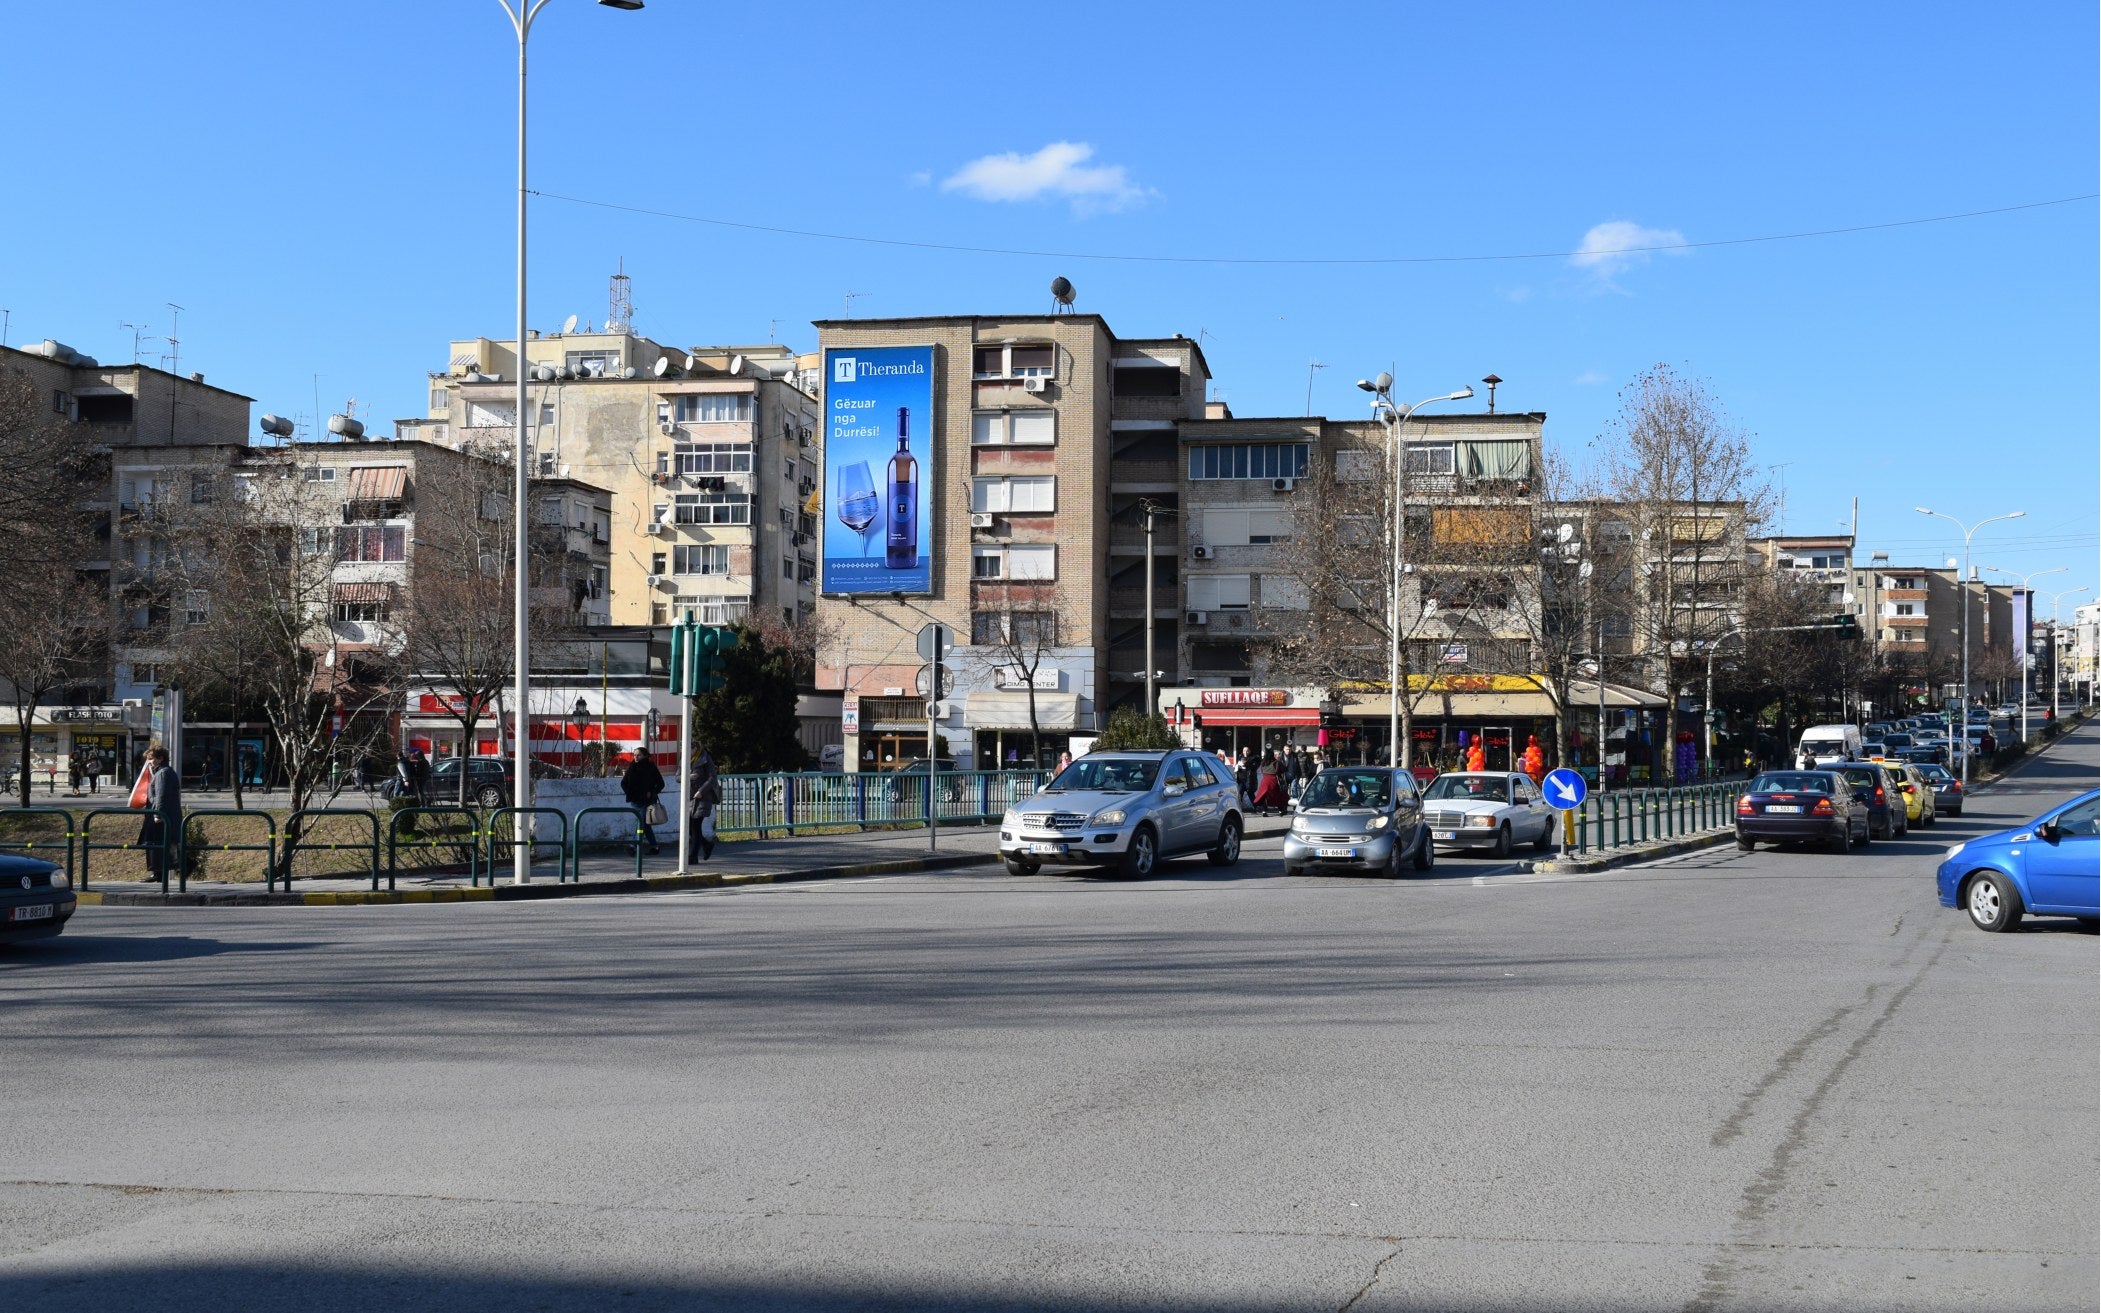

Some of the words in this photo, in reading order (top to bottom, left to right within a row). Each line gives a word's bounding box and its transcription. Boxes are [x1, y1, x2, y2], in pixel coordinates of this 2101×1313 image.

[858, 360, 924, 377] Theranda
[835, 399, 876, 410] Gëzuar
[835, 415, 856, 426] nga
[835, 426, 880, 438] Durrësi!
[1204, 691, 1269, 704] SUFLLAQE
[68, 711, 91, 719] FLASH
[94, 711, 113, 719] FOTO
[76, 736, 99, 744] FOTO
